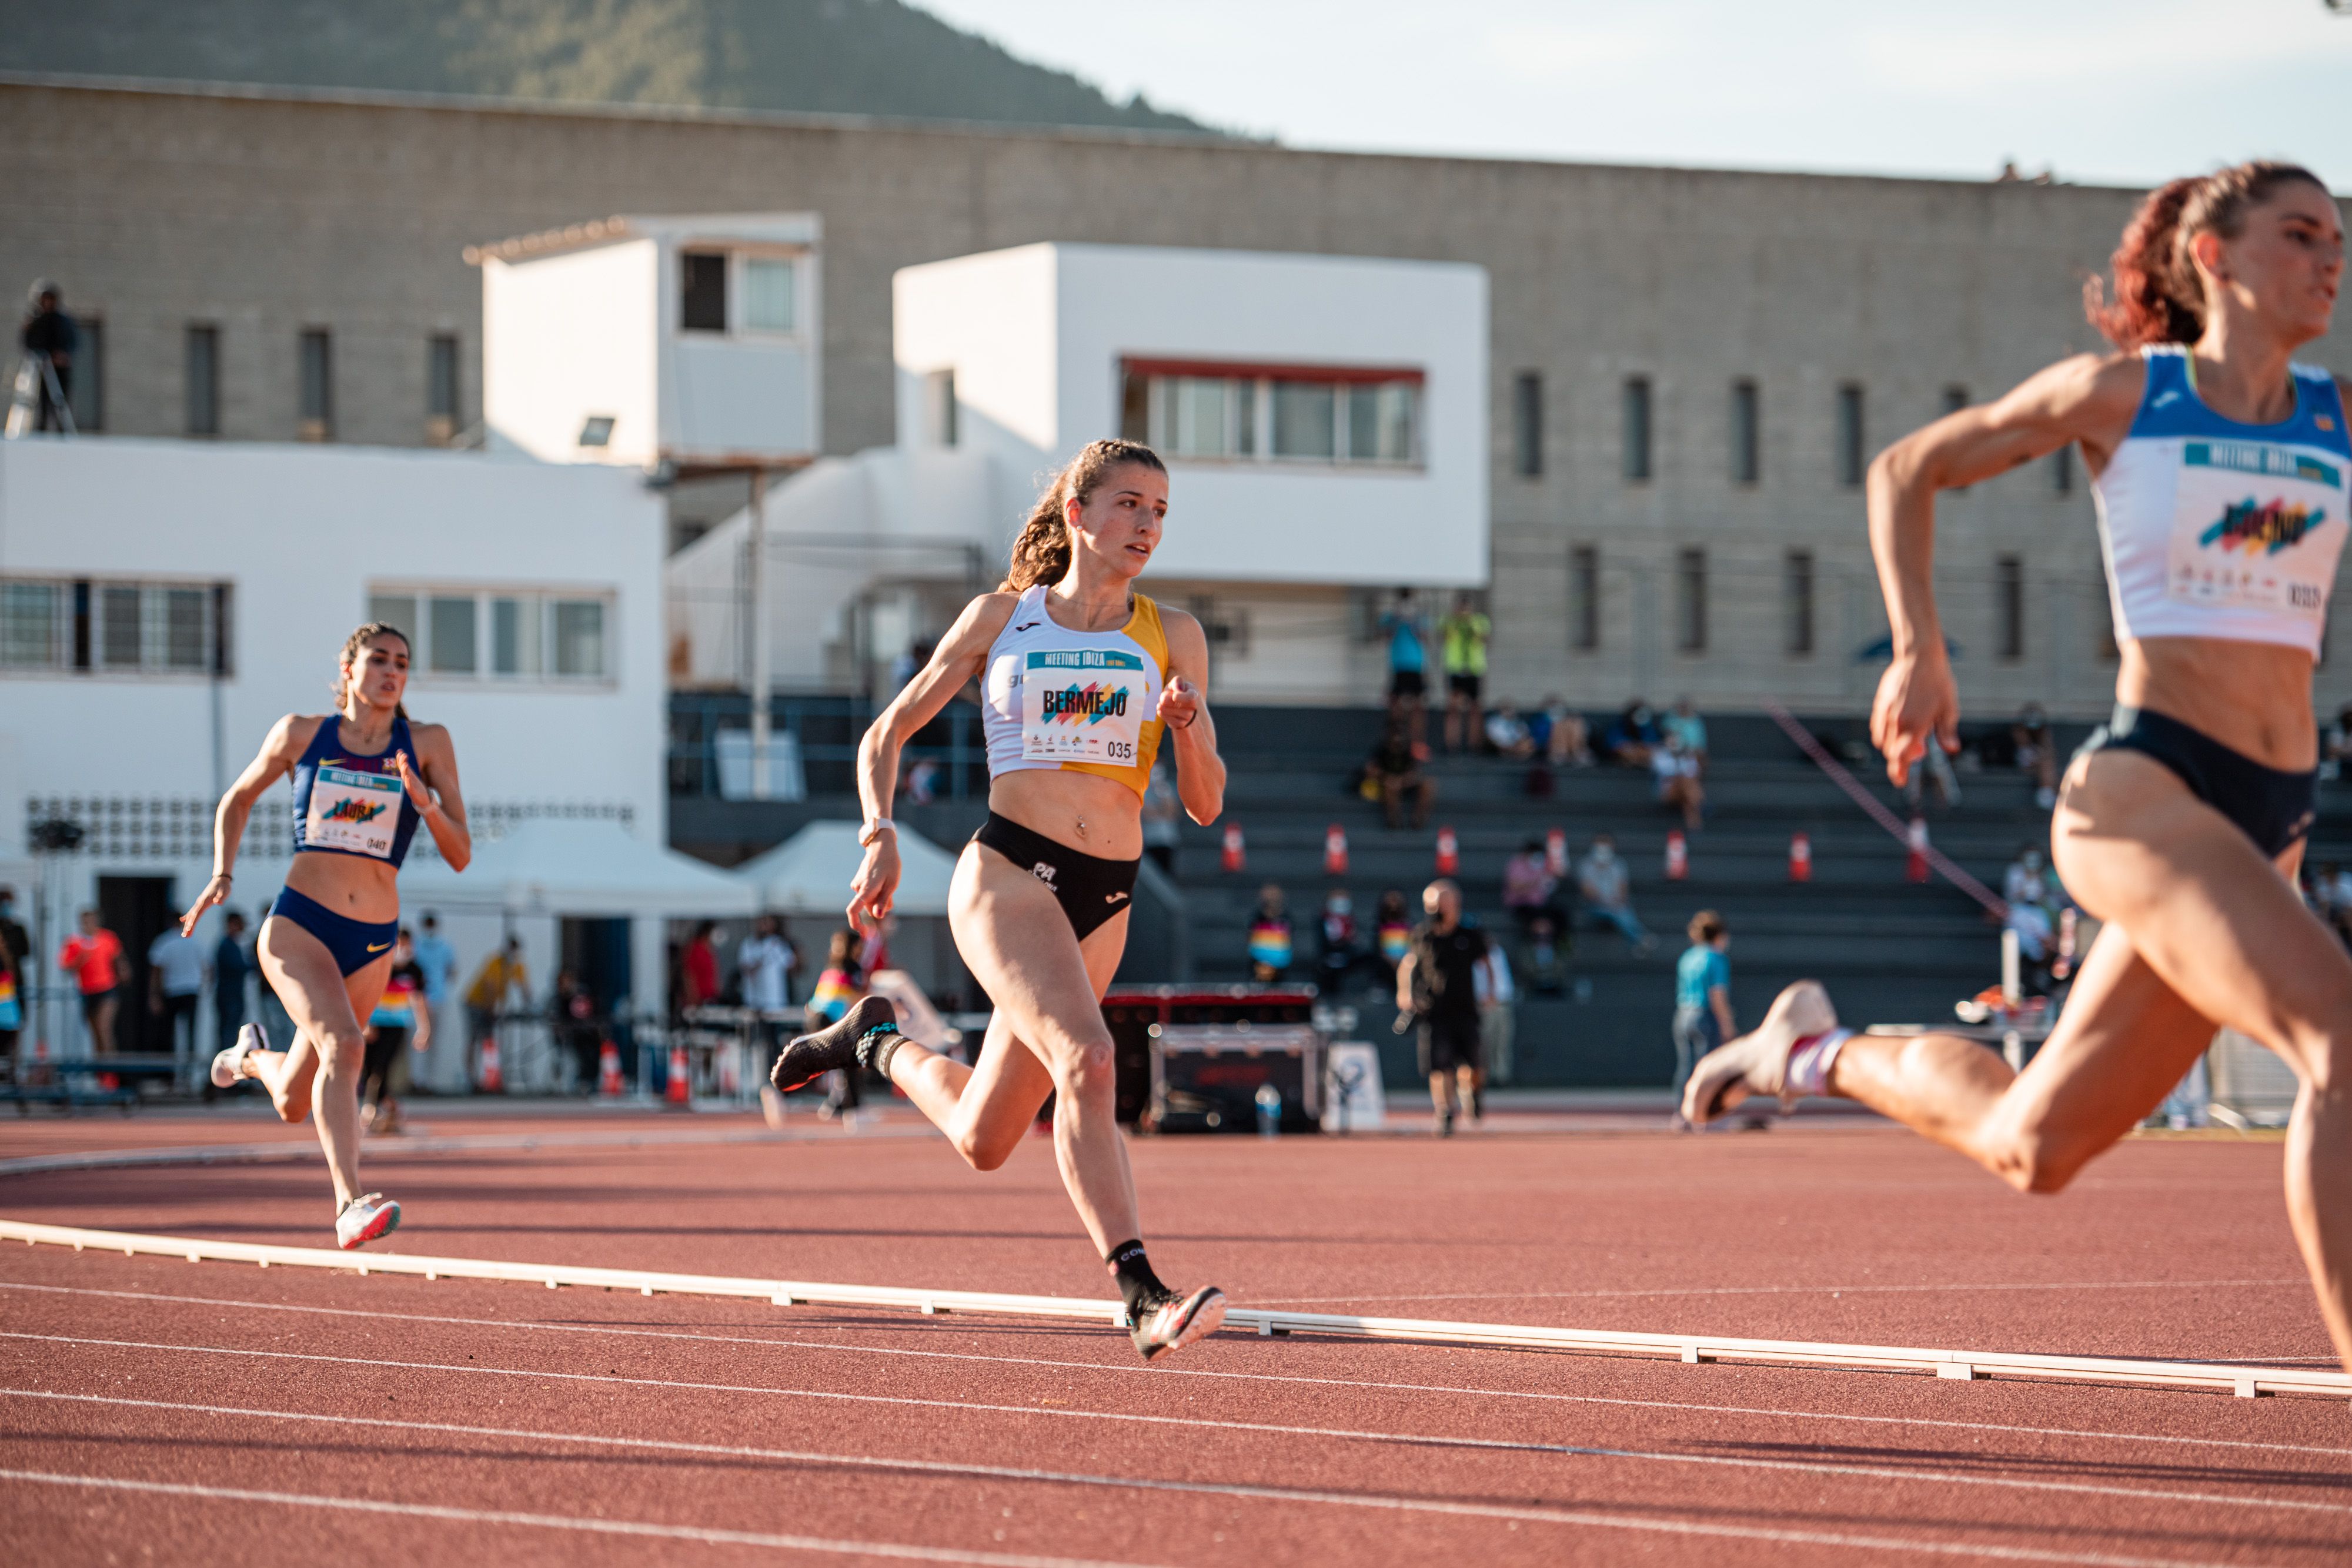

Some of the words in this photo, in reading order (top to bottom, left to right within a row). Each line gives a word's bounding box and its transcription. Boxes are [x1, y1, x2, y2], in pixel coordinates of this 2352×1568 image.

[1045, 653, 1080, 666] MEETING
[1083, 651, 1105, 666] IBIZA
[1043, 690, 1127, 717] BERMEJO
[1108, 741, 1131, 758] 035
[333, 800, 375, 821] LAURA
